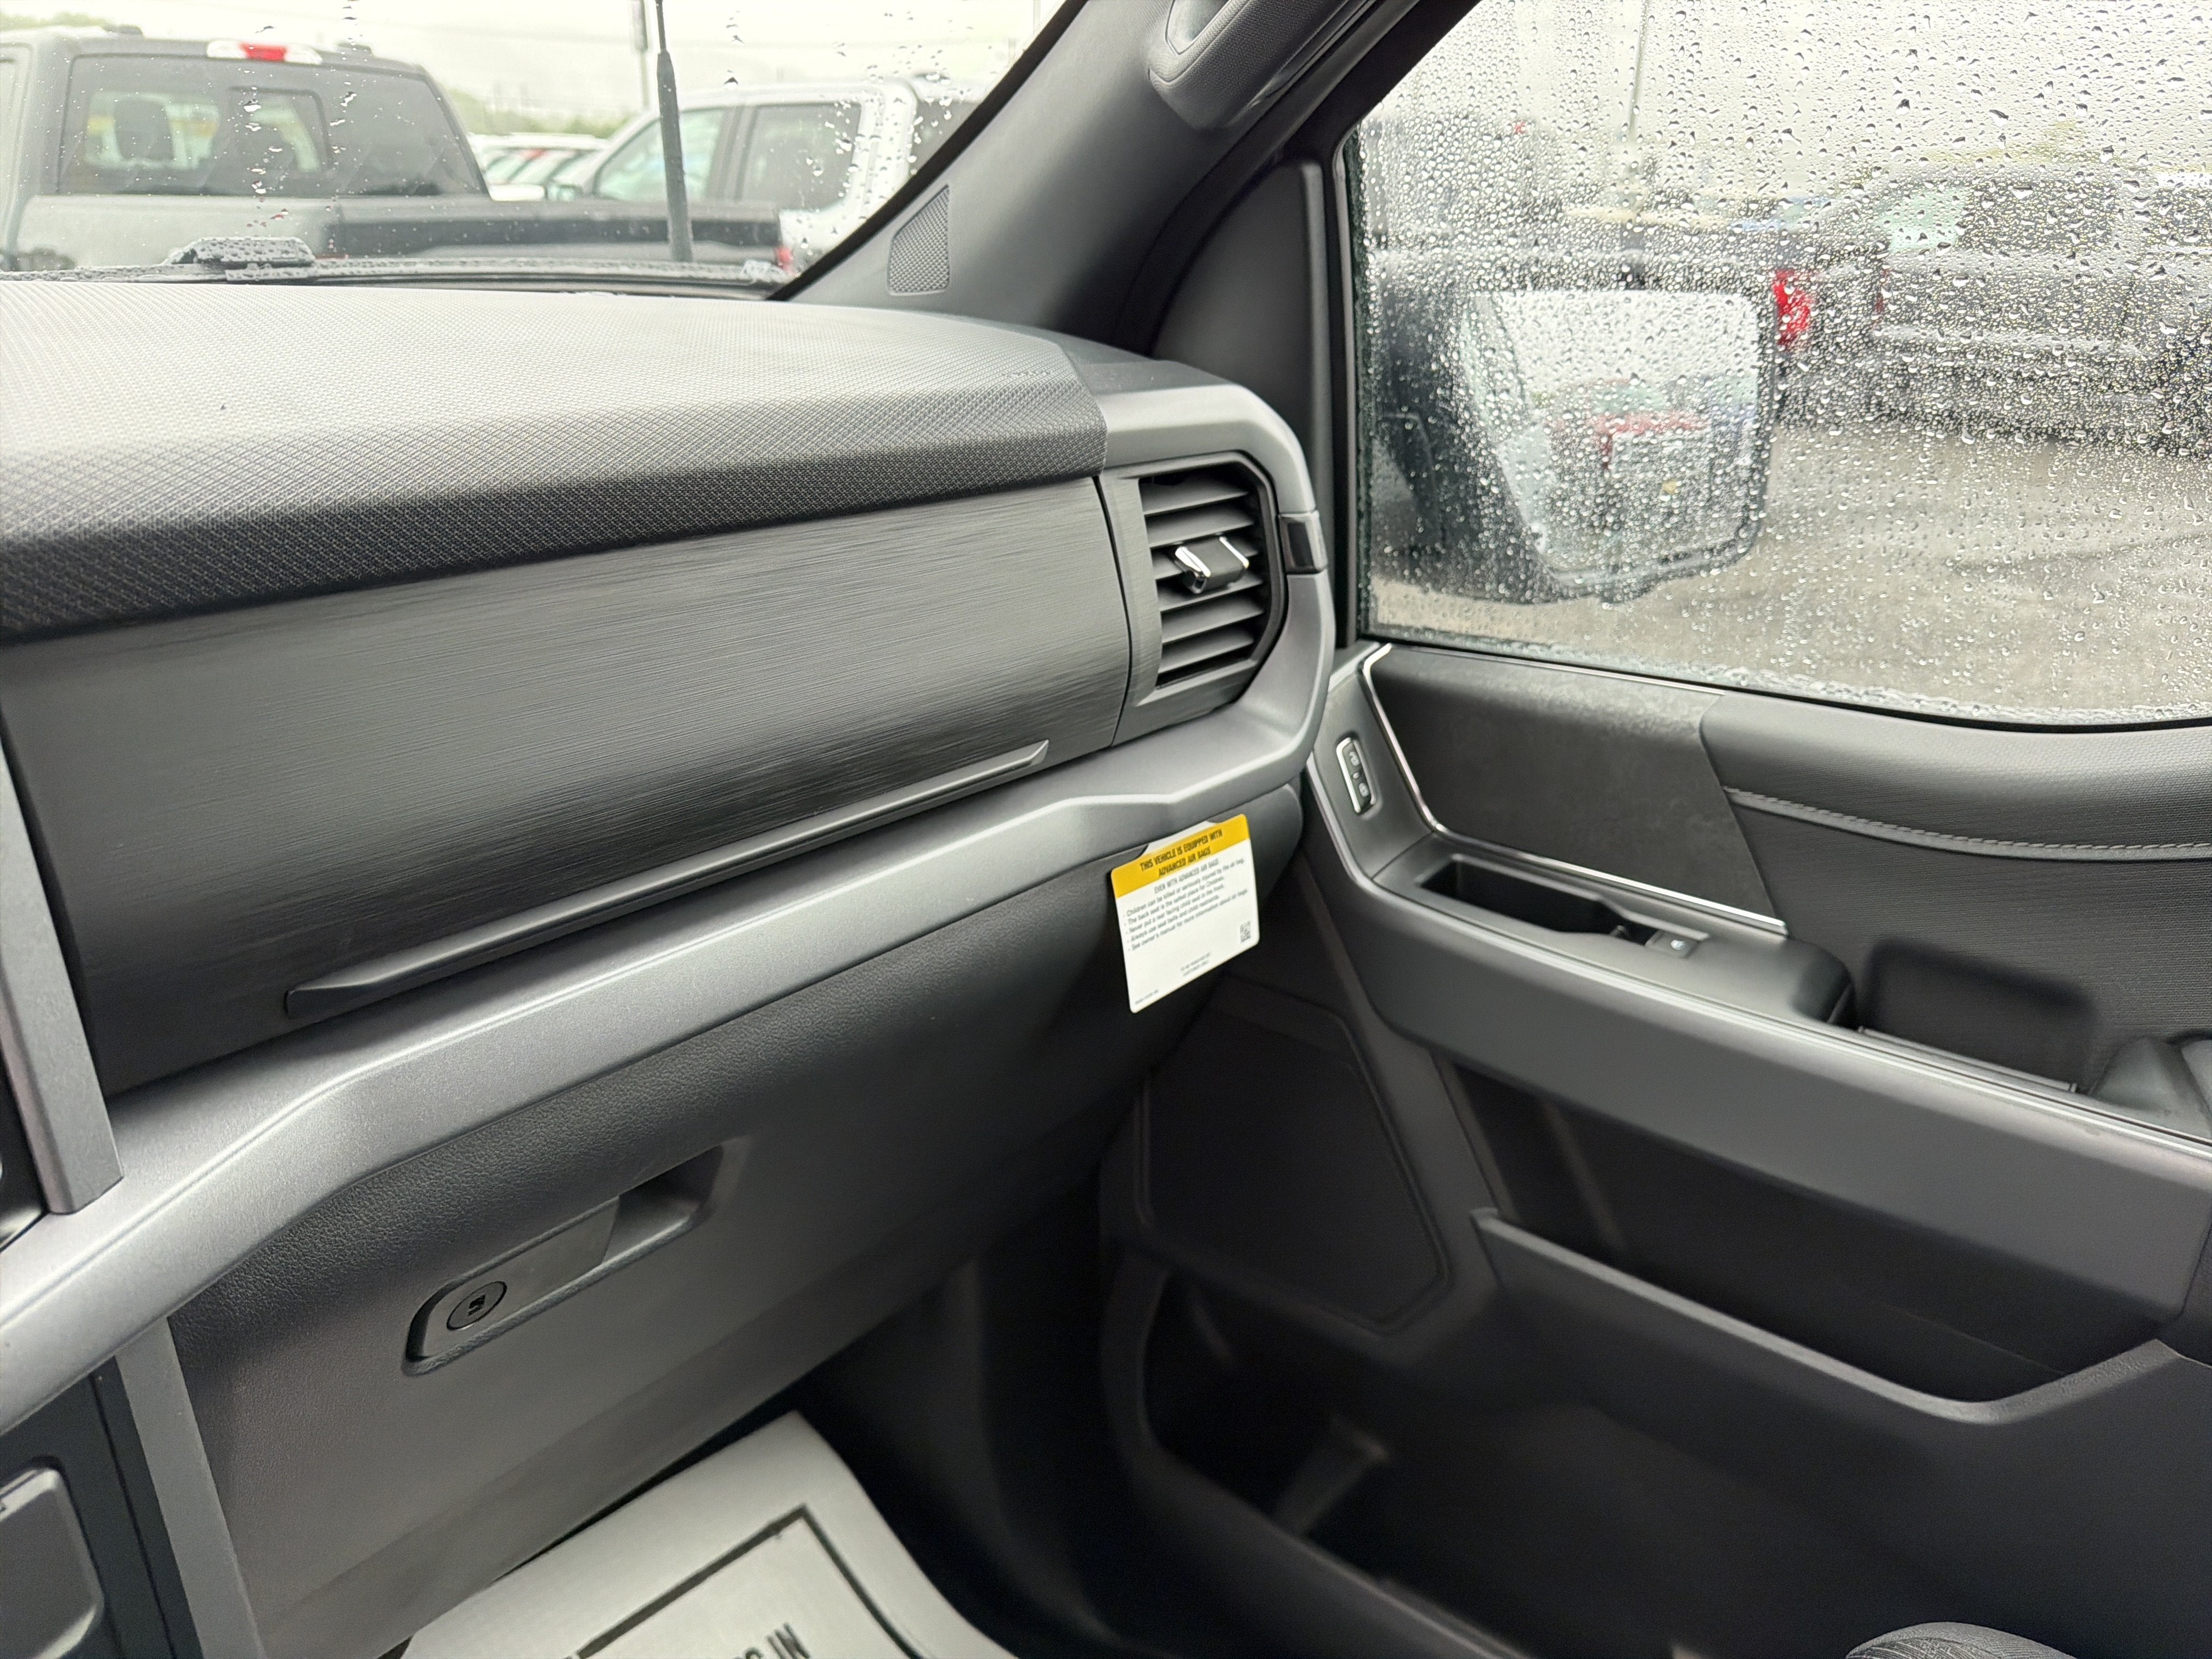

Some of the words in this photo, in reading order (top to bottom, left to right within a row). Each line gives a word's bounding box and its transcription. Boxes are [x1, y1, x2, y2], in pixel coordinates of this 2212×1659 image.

[1140, 859, 1153, 871] THIS
[1154, 849, 1176, 865] VEHICLE
[1177, 847, 1182, 855] IS
[1183, 835, 1208, 852] EQUIPPED
[1210, 829, 1222, 840] WITH
[1158, 858, 1186, 876] ADVANCED
[1188, 854, 1196, 863] AIR
[1198, 847, 1211, 859] BAGS
[1154, 883, 1165, 893] EVEN
[1167, 878, 1177, 887] WITH
[1179, 868, 1199, 882] ADVANCED
[1209, 859, 1218, 868] BAGS
[1127, 903, 1146, 916] Children
[1138, 911, 1149, 919] back
